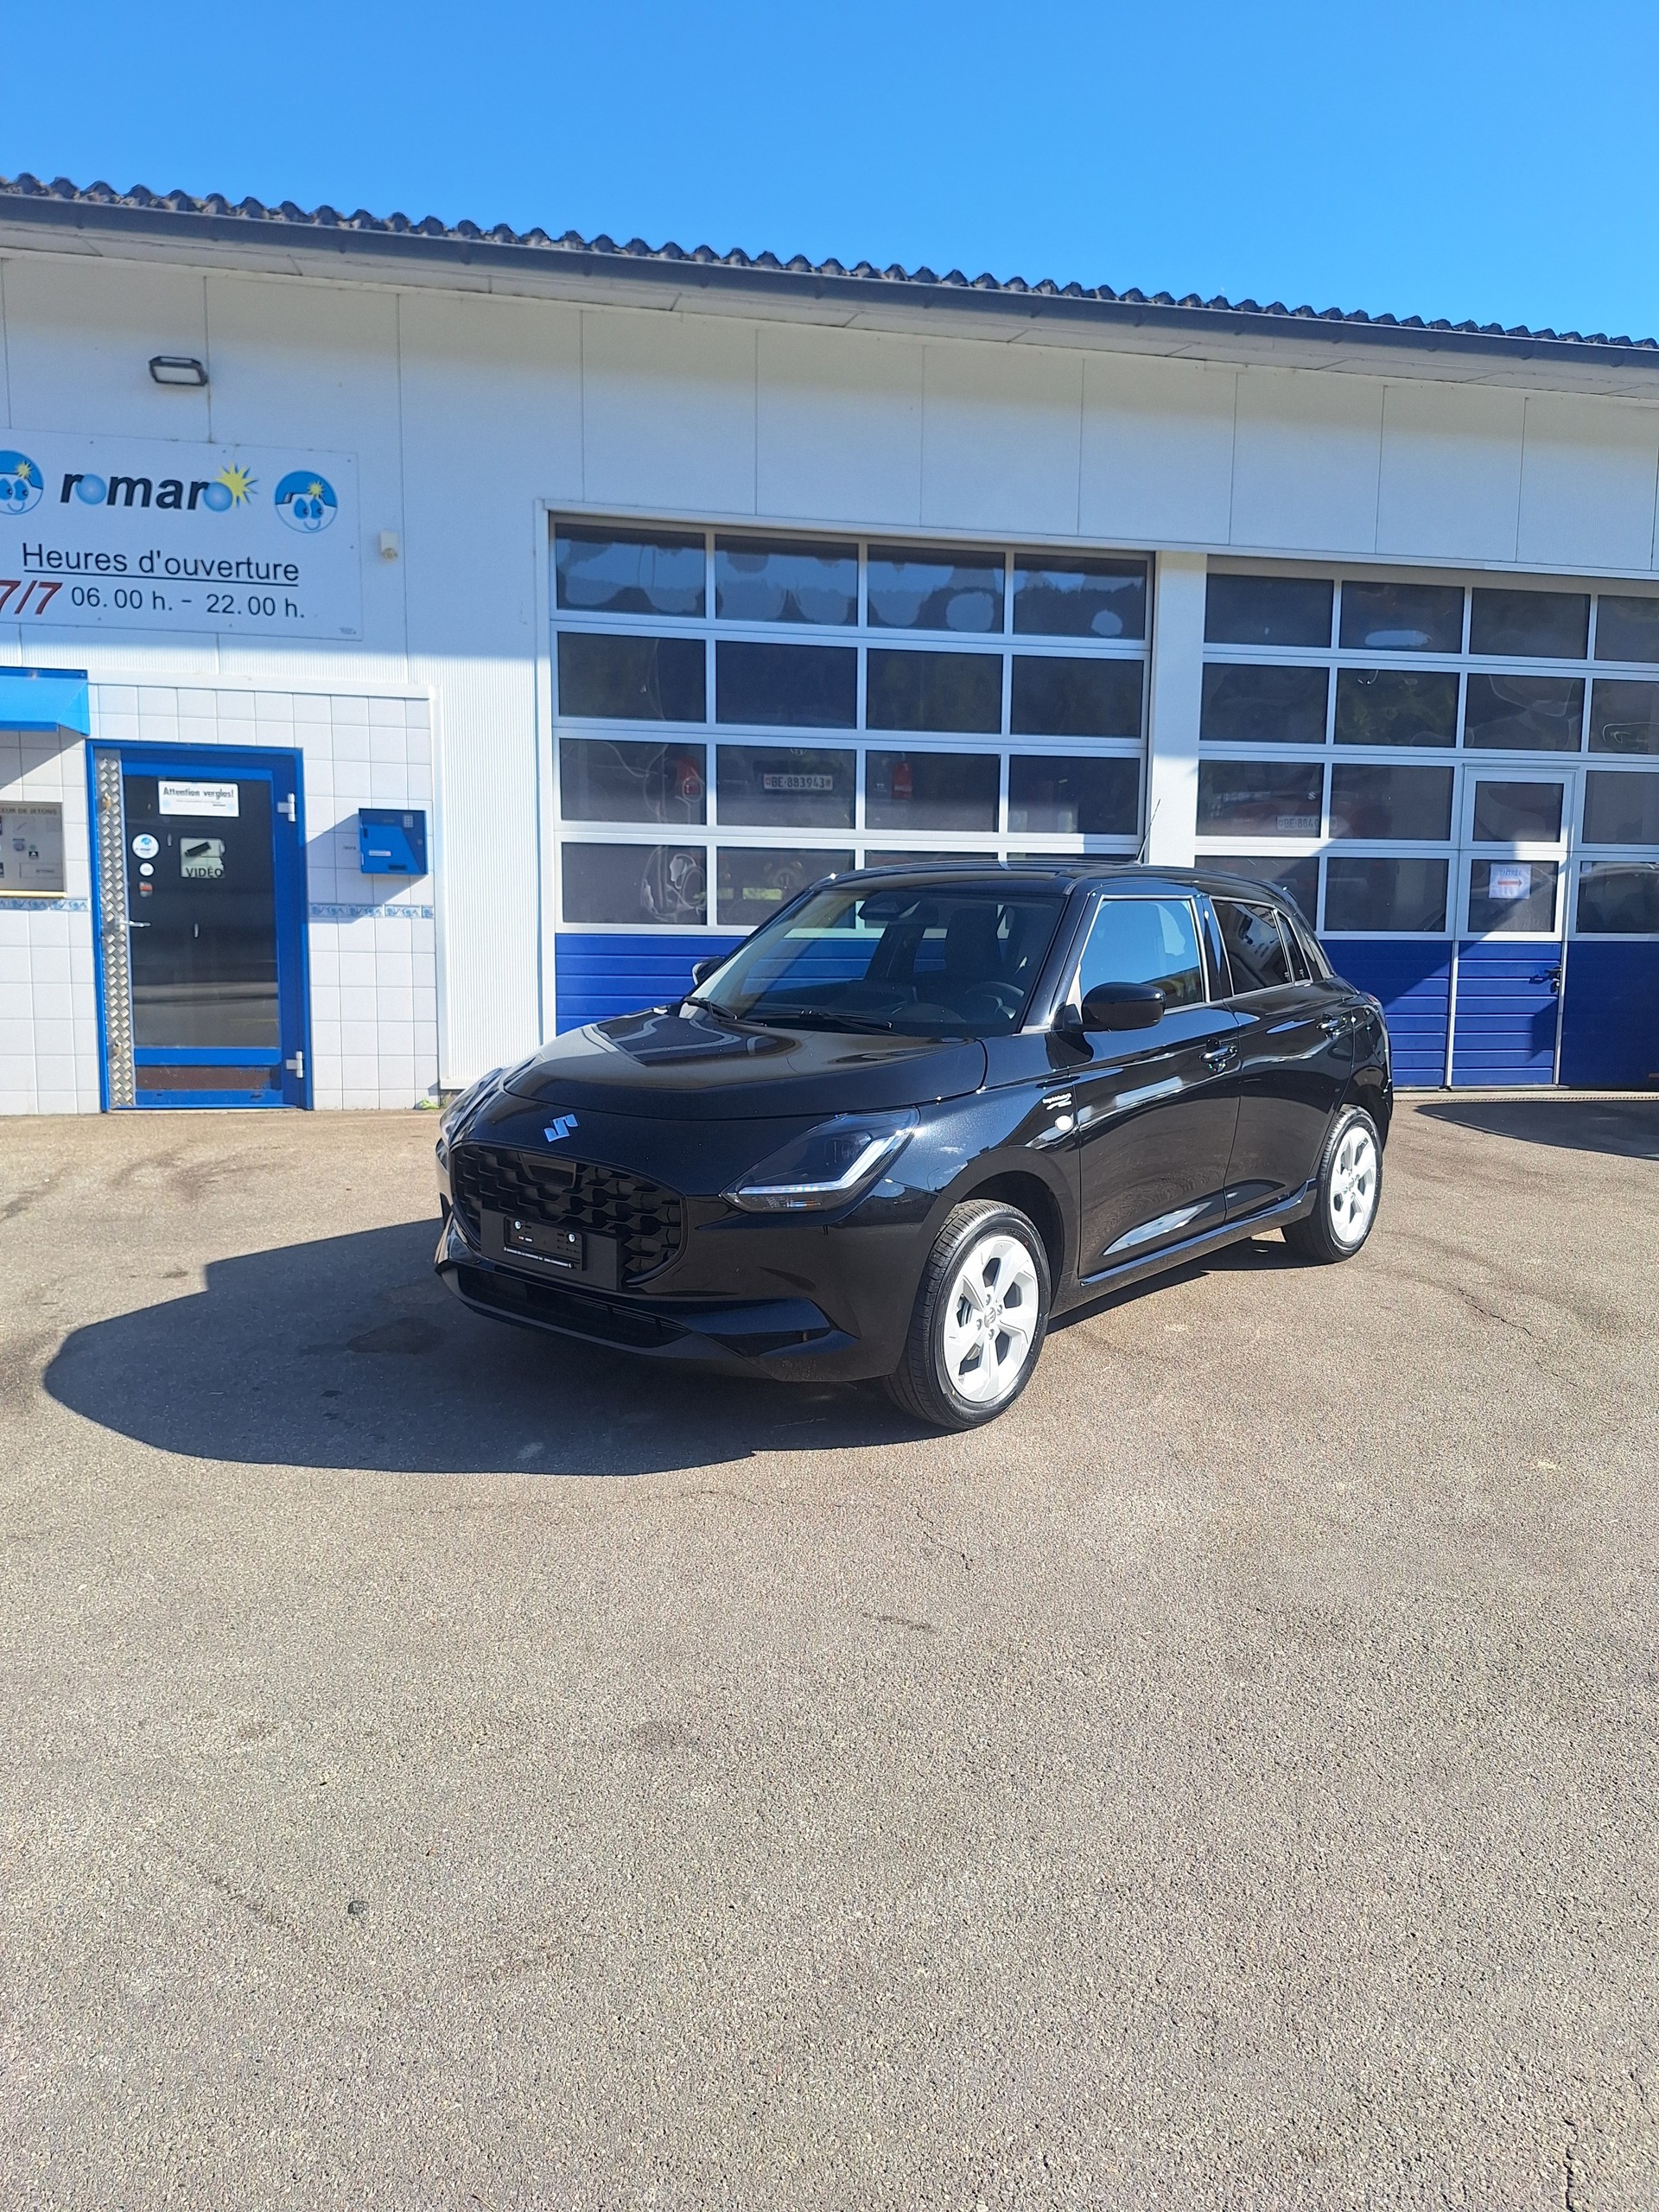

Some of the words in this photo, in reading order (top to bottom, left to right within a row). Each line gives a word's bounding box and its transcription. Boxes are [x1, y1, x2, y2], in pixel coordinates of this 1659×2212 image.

[60, 474, 233, 512] romaro
[22, 543, 128, 572] Heures
[139, 550, 299, 582] d'ouverture
[0, 580, 63, 615] 7/7
[71, 587, 143, 609] 06.00
[152, 591, 173, 611] h.
[207, 594, 276, 616] 22.00
[285, 598, 305, 618] h.
[162, 786, 200, 797] Attention
[186, 866, 223, 877] VIDÉO
